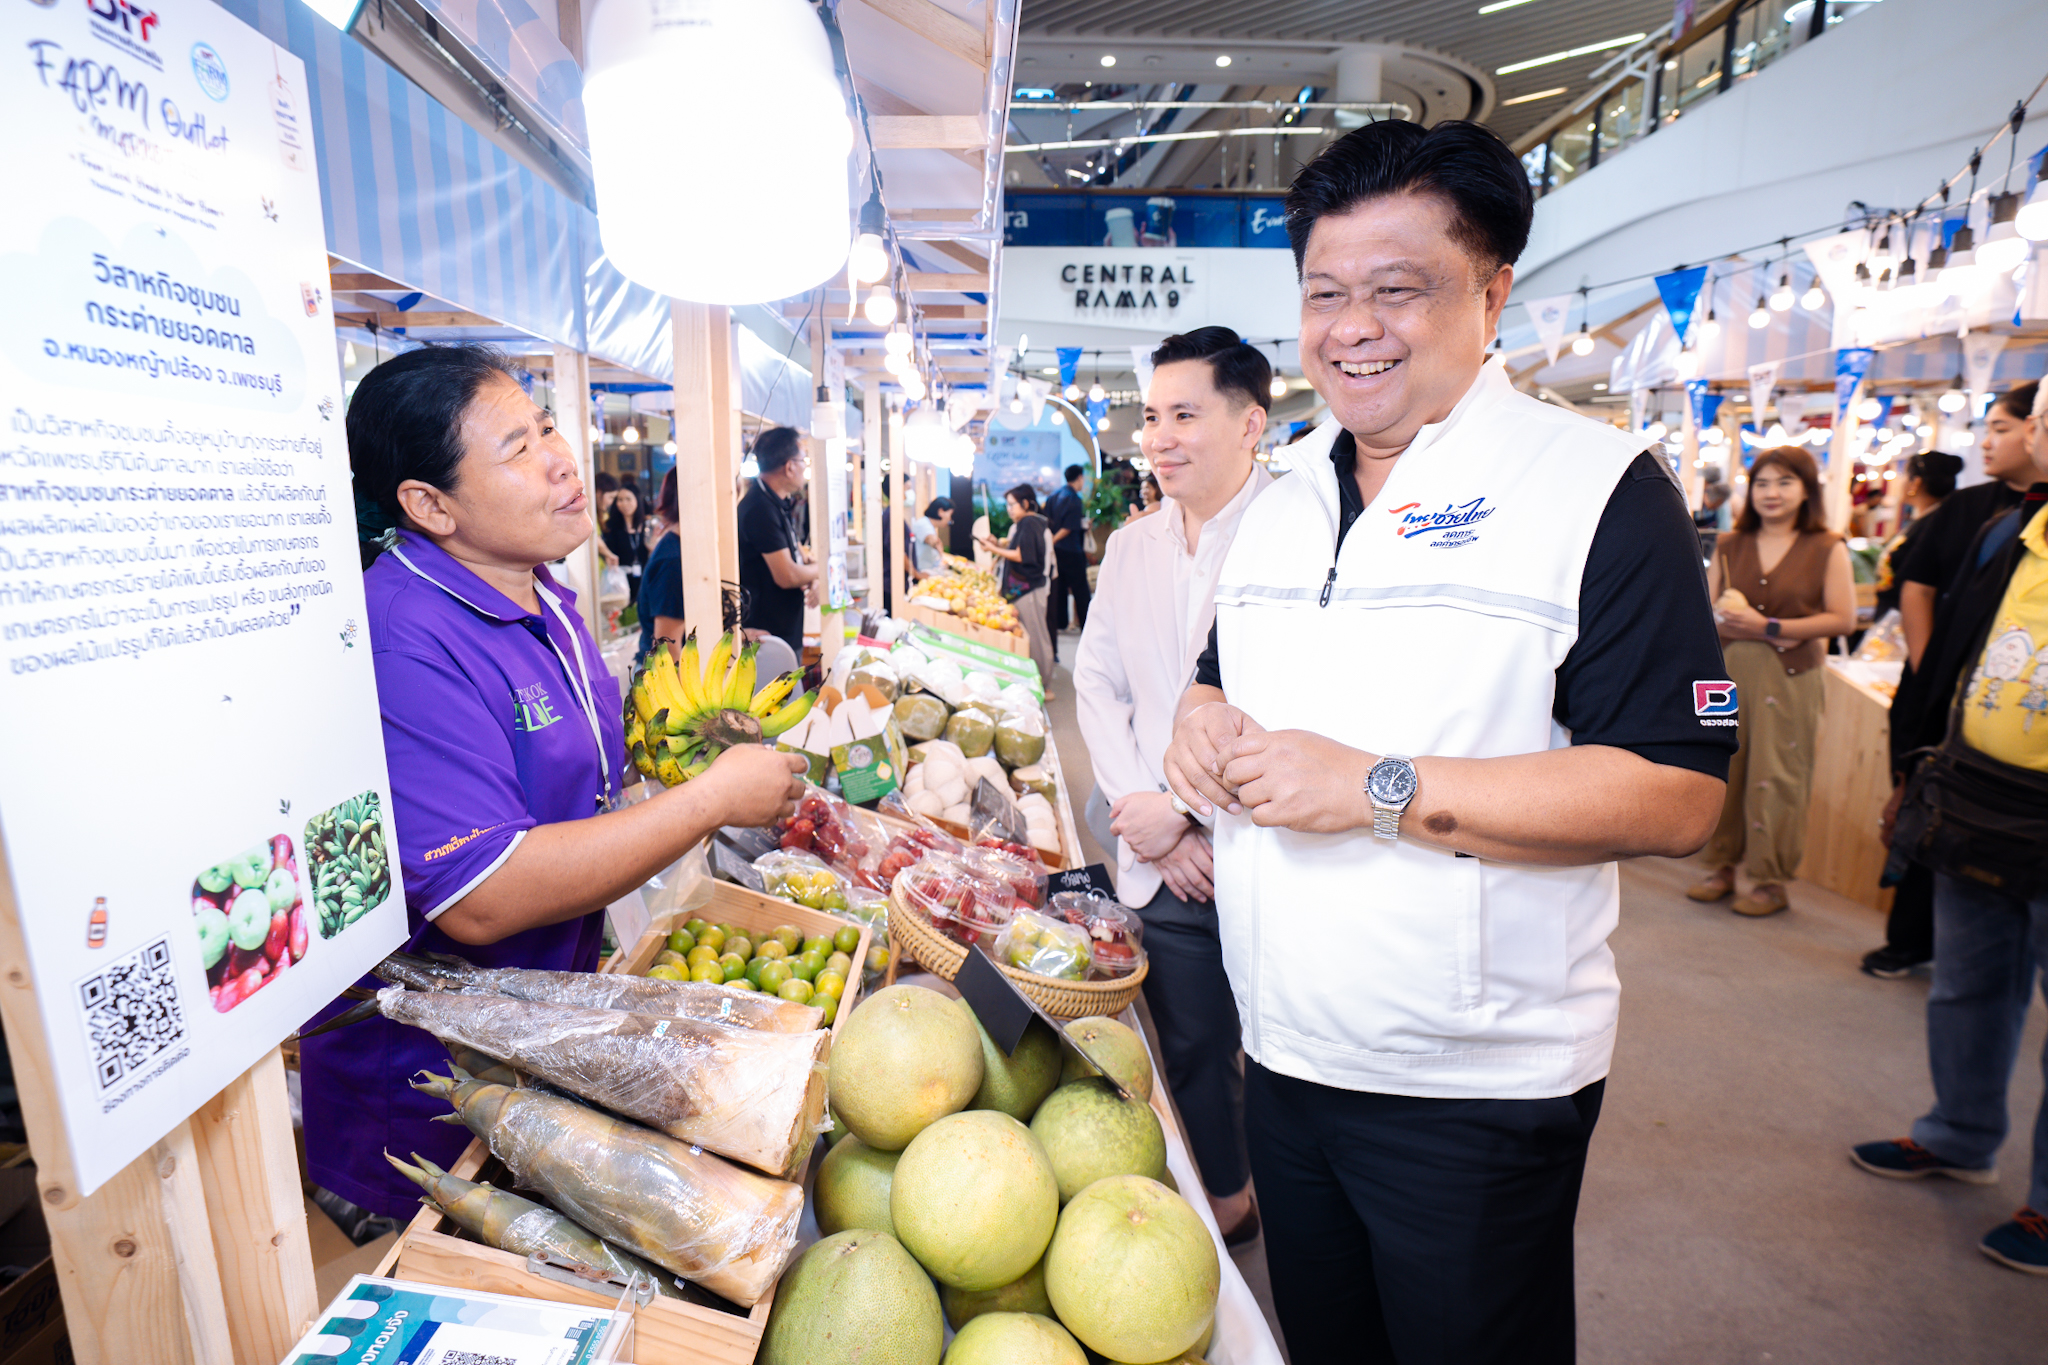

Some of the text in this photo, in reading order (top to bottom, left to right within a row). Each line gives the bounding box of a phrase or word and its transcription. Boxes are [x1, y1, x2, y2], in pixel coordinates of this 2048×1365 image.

[1003, 210, 1029, 229] ra
[93, 252, 241, 318] วิสาหกิจชุมชน
[1061, 263, 1196, 286] CENTRAL
[1074, 289, 1181, 309] RAMA 9
[85, 301, 256, 355] กระต่ายยอดตาล
[43, 338, 283, 397] อ.หนองหญ้าปล้อง จ.เพชรบุรี
[241, 586, 266, 607] หรือ
[102, 1046, 191, 1115] ช่องทางการติดต่อ
